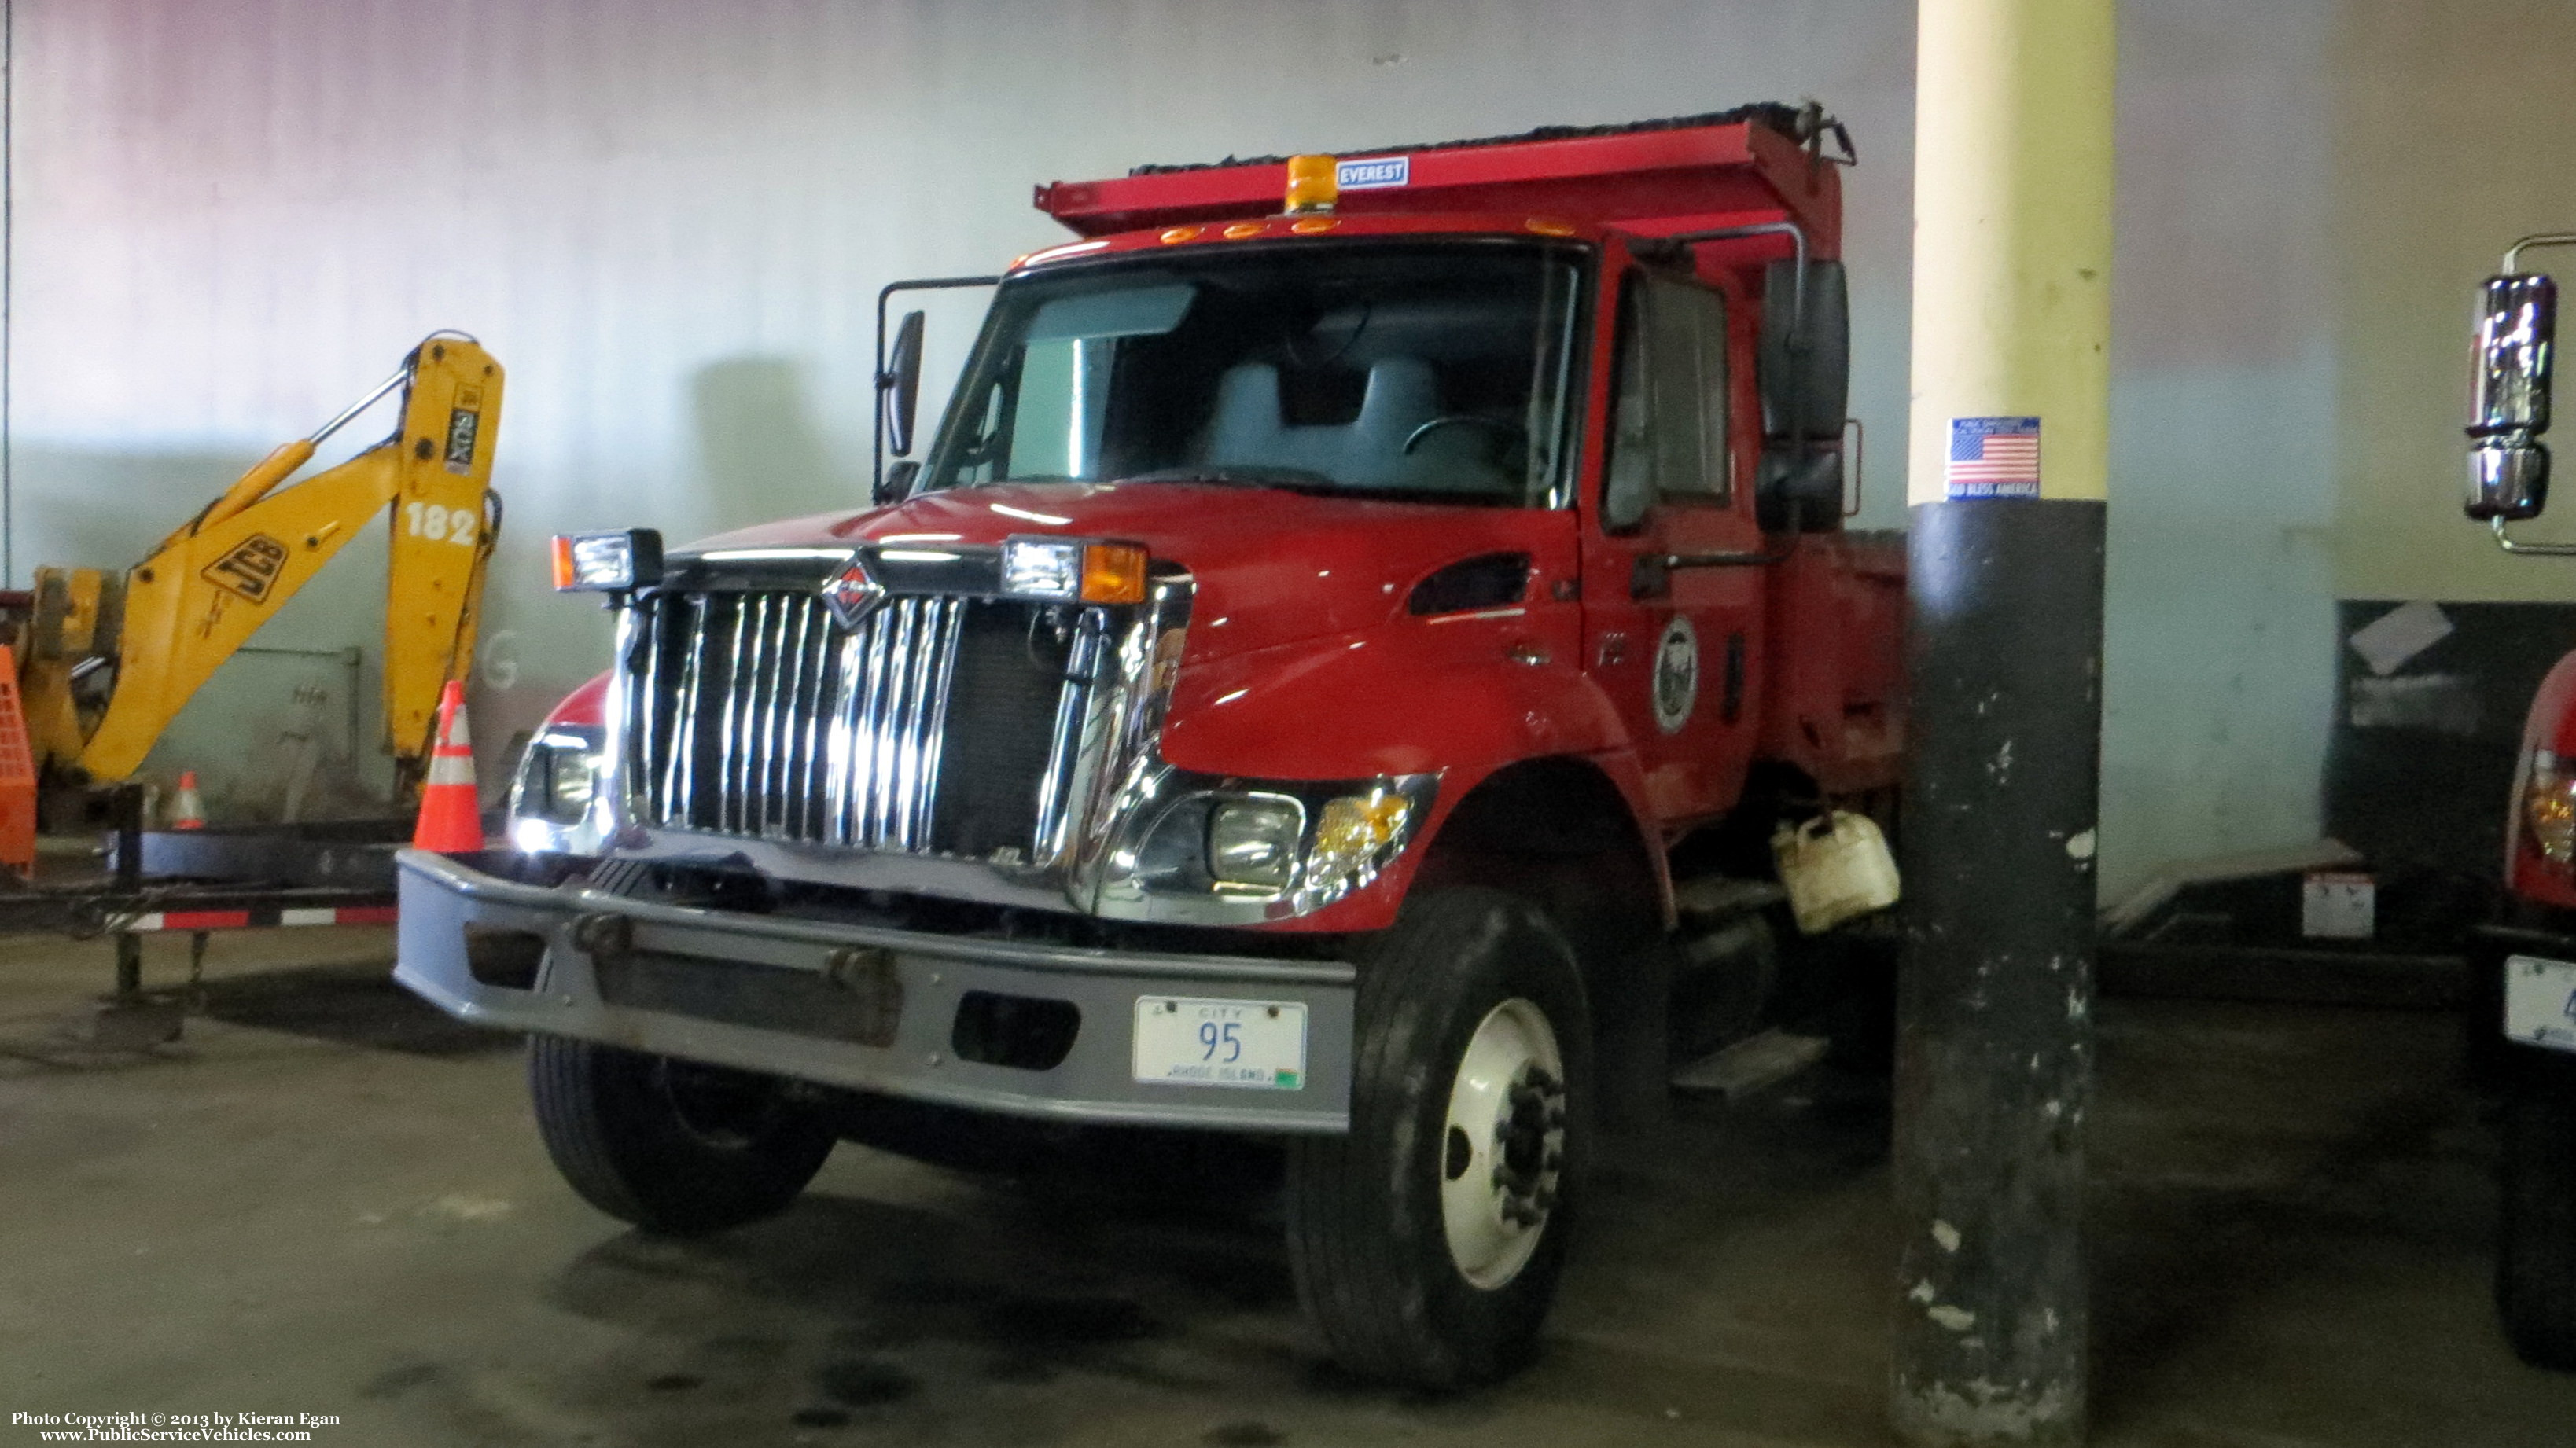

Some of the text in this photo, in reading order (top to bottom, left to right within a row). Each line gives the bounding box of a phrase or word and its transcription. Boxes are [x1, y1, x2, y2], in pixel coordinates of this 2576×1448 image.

[1341, 163, 1404, 183] EVEREST
[406, 502, 476, 546] 182
[216, 538, 284, 596] JCB
[1198, 1006, 1242, 1020] CITY
[1199, 1022, 1242, 1063] 95
